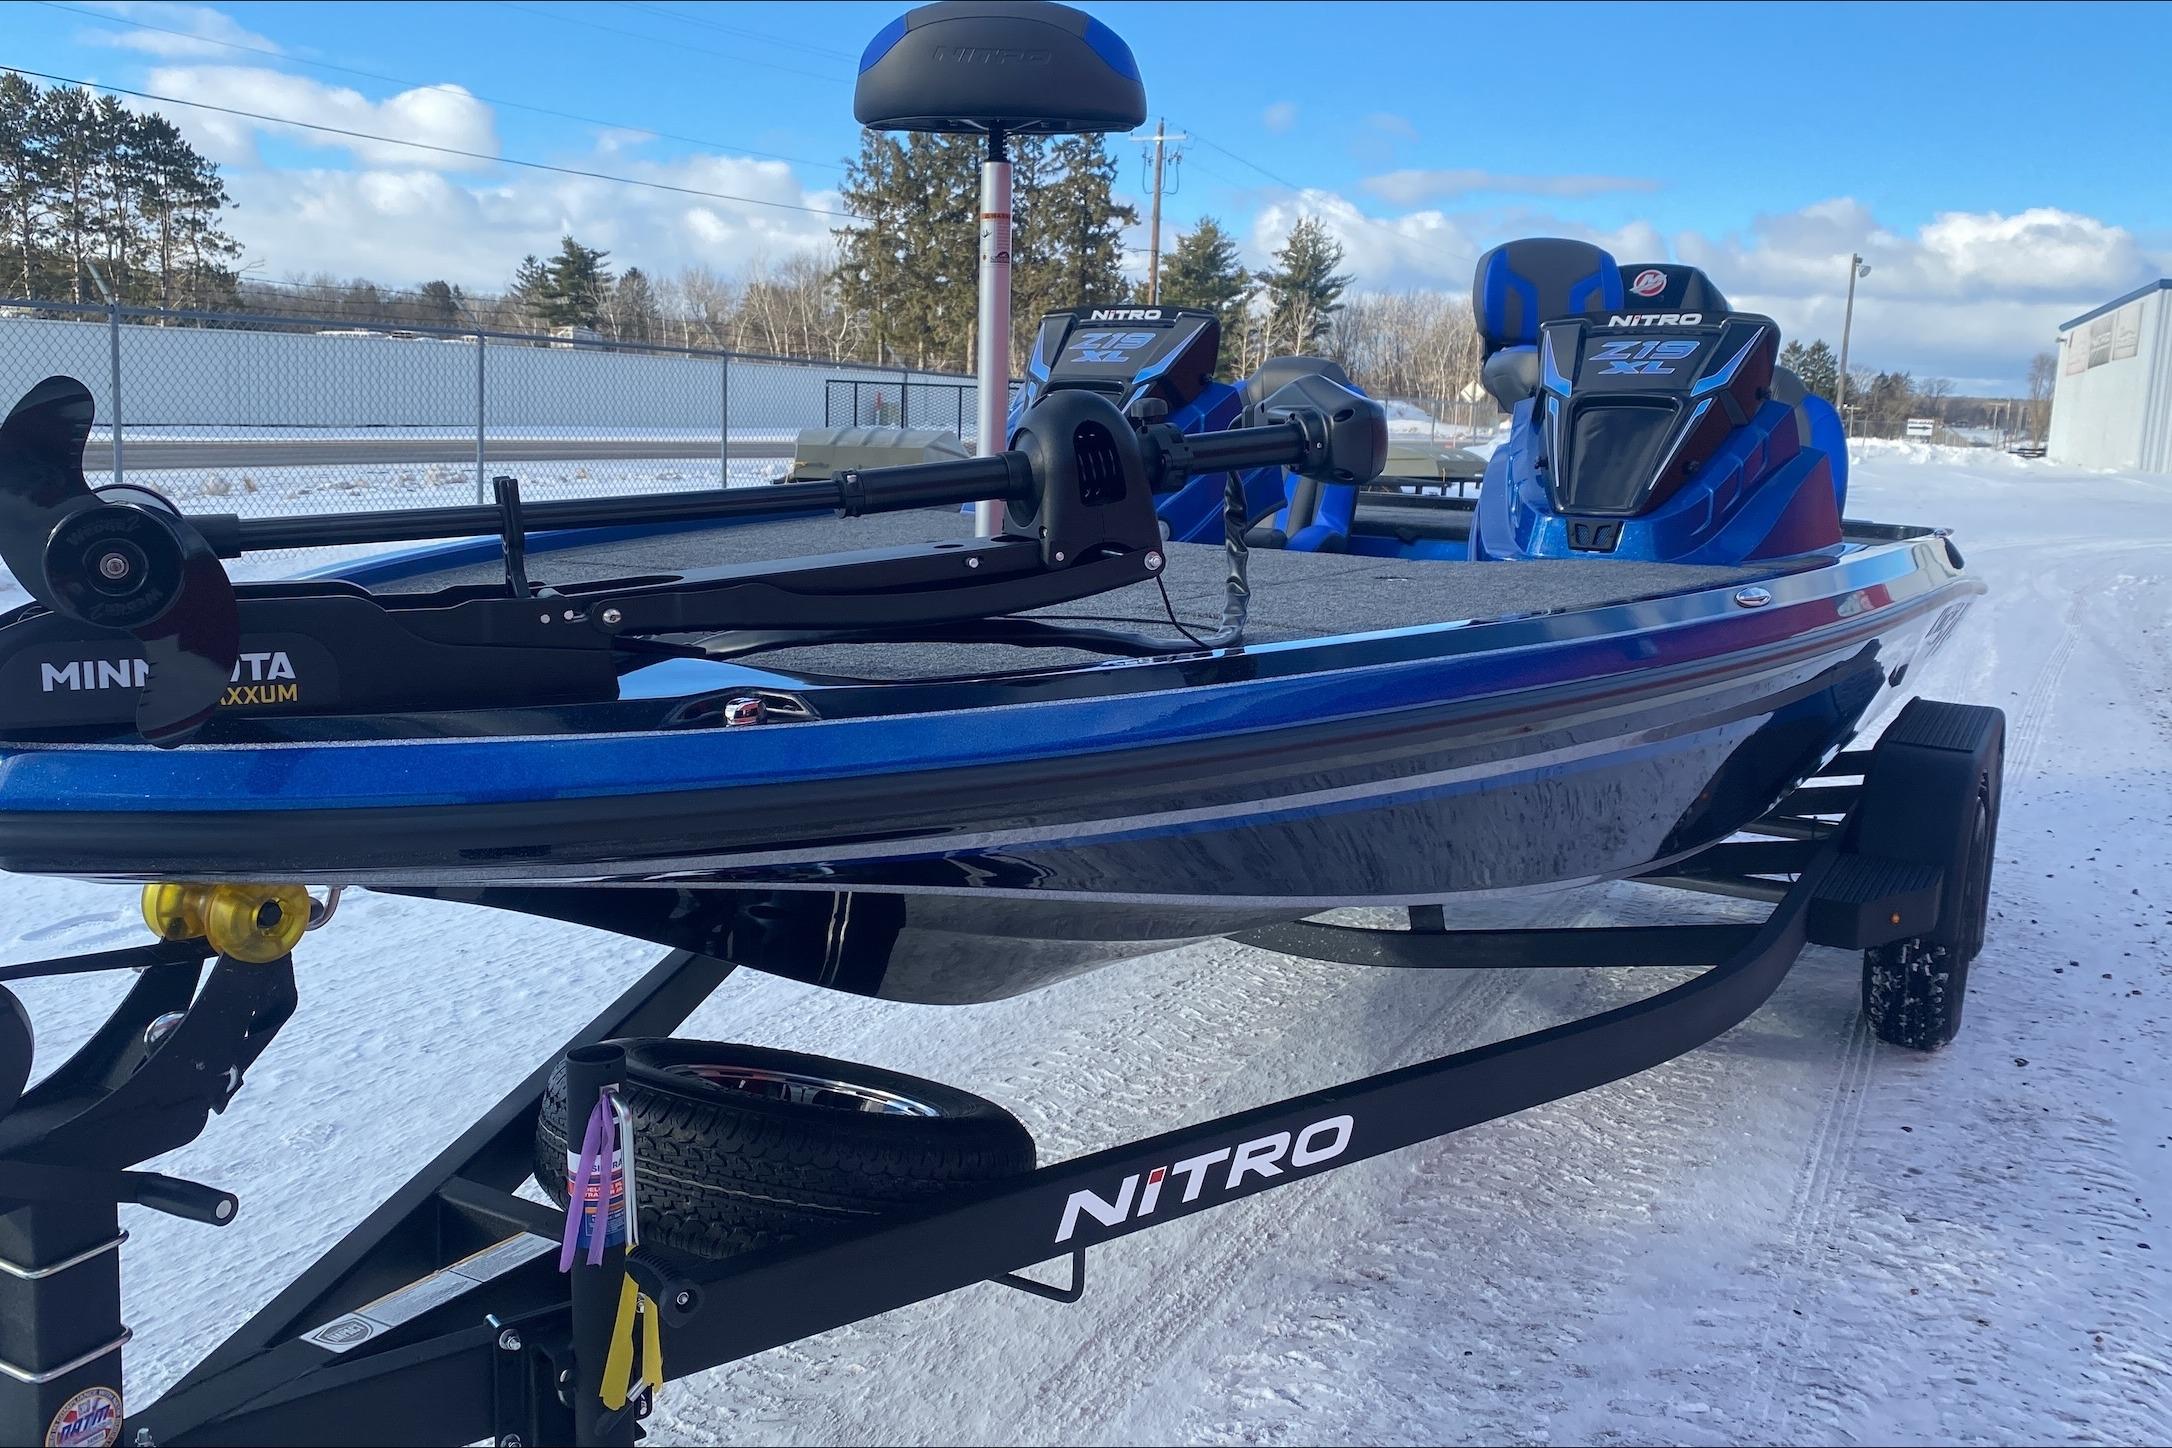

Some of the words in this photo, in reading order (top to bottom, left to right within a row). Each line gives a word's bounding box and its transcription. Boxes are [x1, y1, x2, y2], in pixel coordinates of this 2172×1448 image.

[1607, 313, 1703, 328] NITRO
[1068, 332, 1157, 350] Z19
[1588, 340, 1701, 360] Z19
[1071, 350, 1130, 362] XL
[1598, 361, 1676, 375] XL
[230, 651, 297, 683] TA
[219, 683, 298, 706] XXUM
[1054, 1114, 1354, 1244] NITRO
